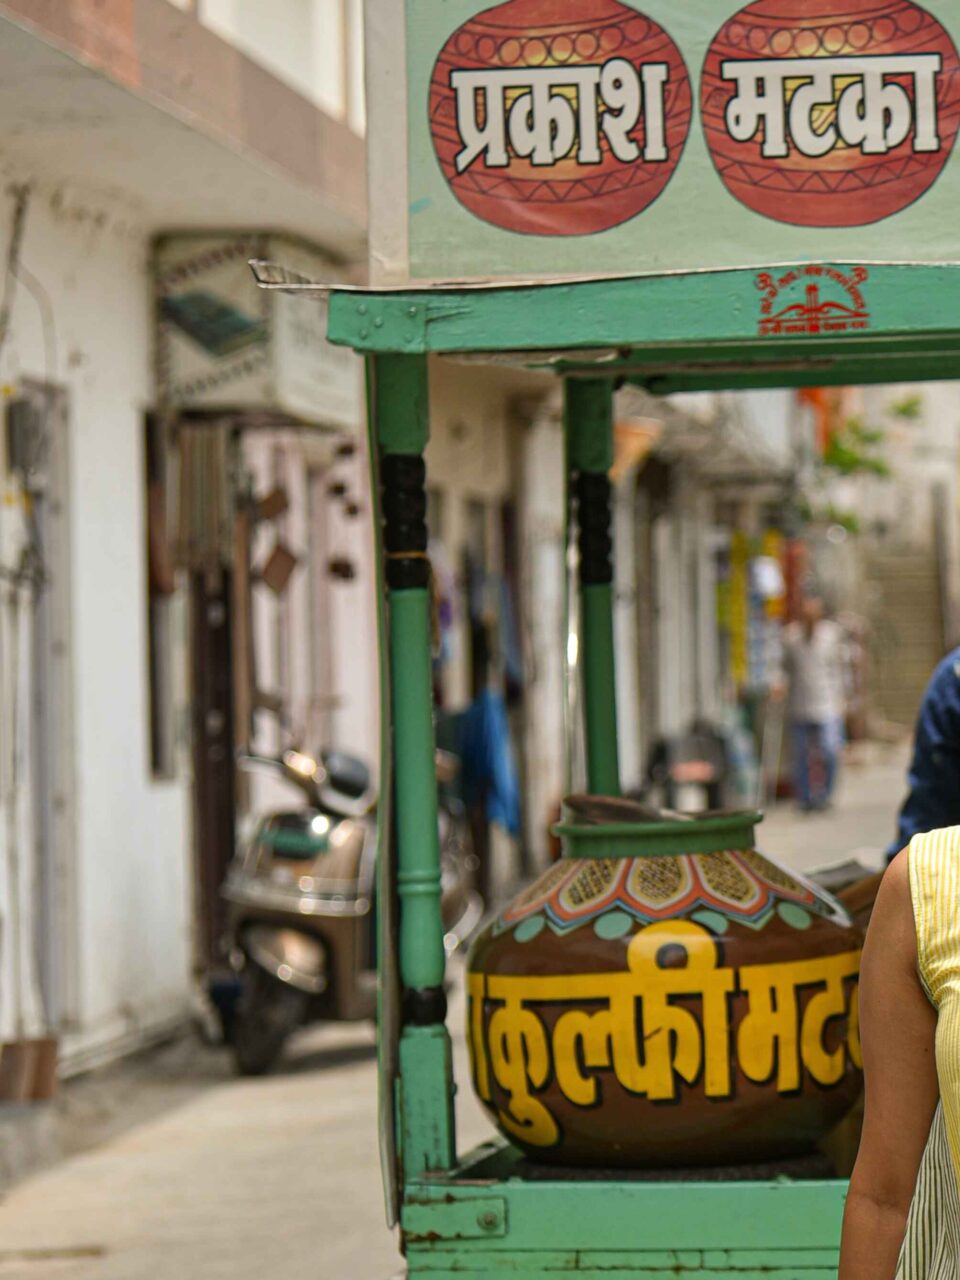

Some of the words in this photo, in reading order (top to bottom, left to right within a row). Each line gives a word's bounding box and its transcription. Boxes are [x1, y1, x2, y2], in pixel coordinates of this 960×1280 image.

[450, 57, 669, 174] प्रकाश
[720, 53, 943, 157] मटका
[486, 919, 735, 1148] कुल्फी
[739, 950, 863, 1092] मट
